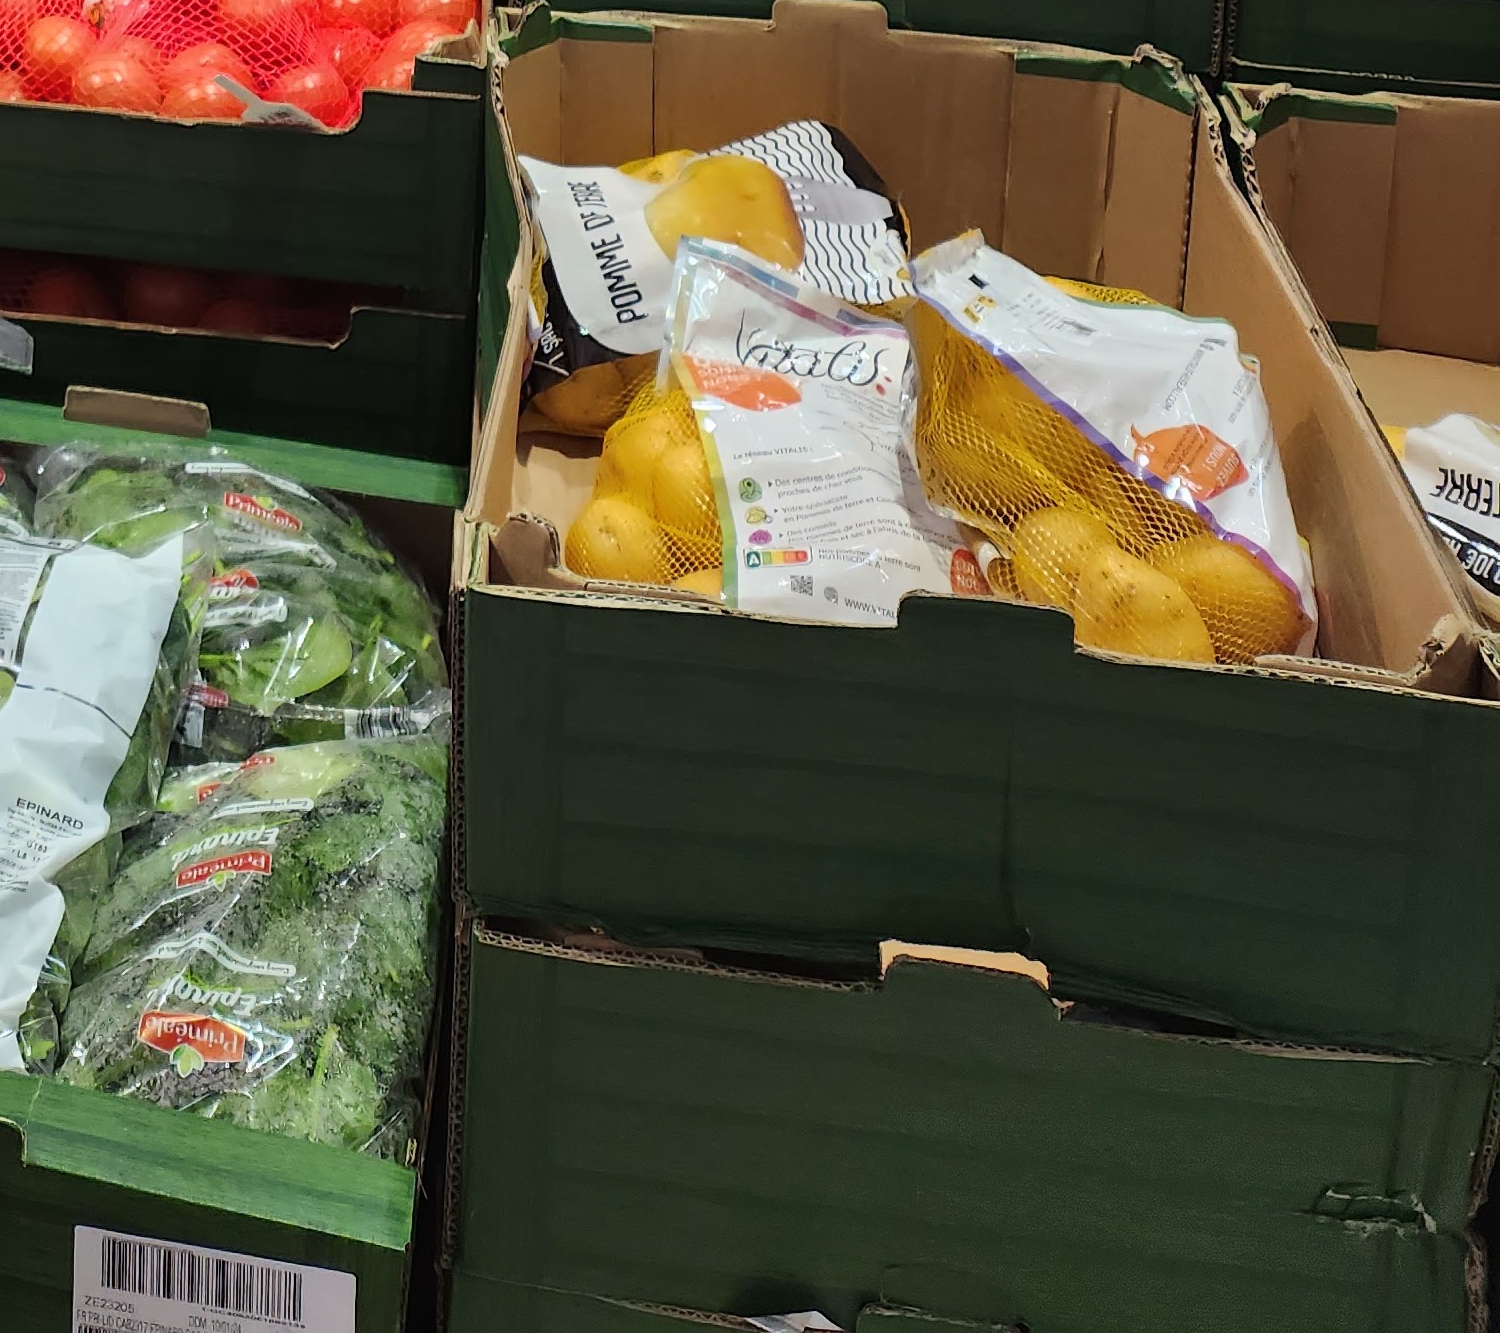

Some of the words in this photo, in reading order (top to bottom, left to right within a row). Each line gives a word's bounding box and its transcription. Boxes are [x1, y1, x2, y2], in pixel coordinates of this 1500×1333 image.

[579, 212, 615, 232] DE
[591, 233, 649, 324] POMME
[16, 797, 84, 830] EPINARD
[172, 827, 280, 872] Epinard
[146, 1016, 238, 1054] Priméale
